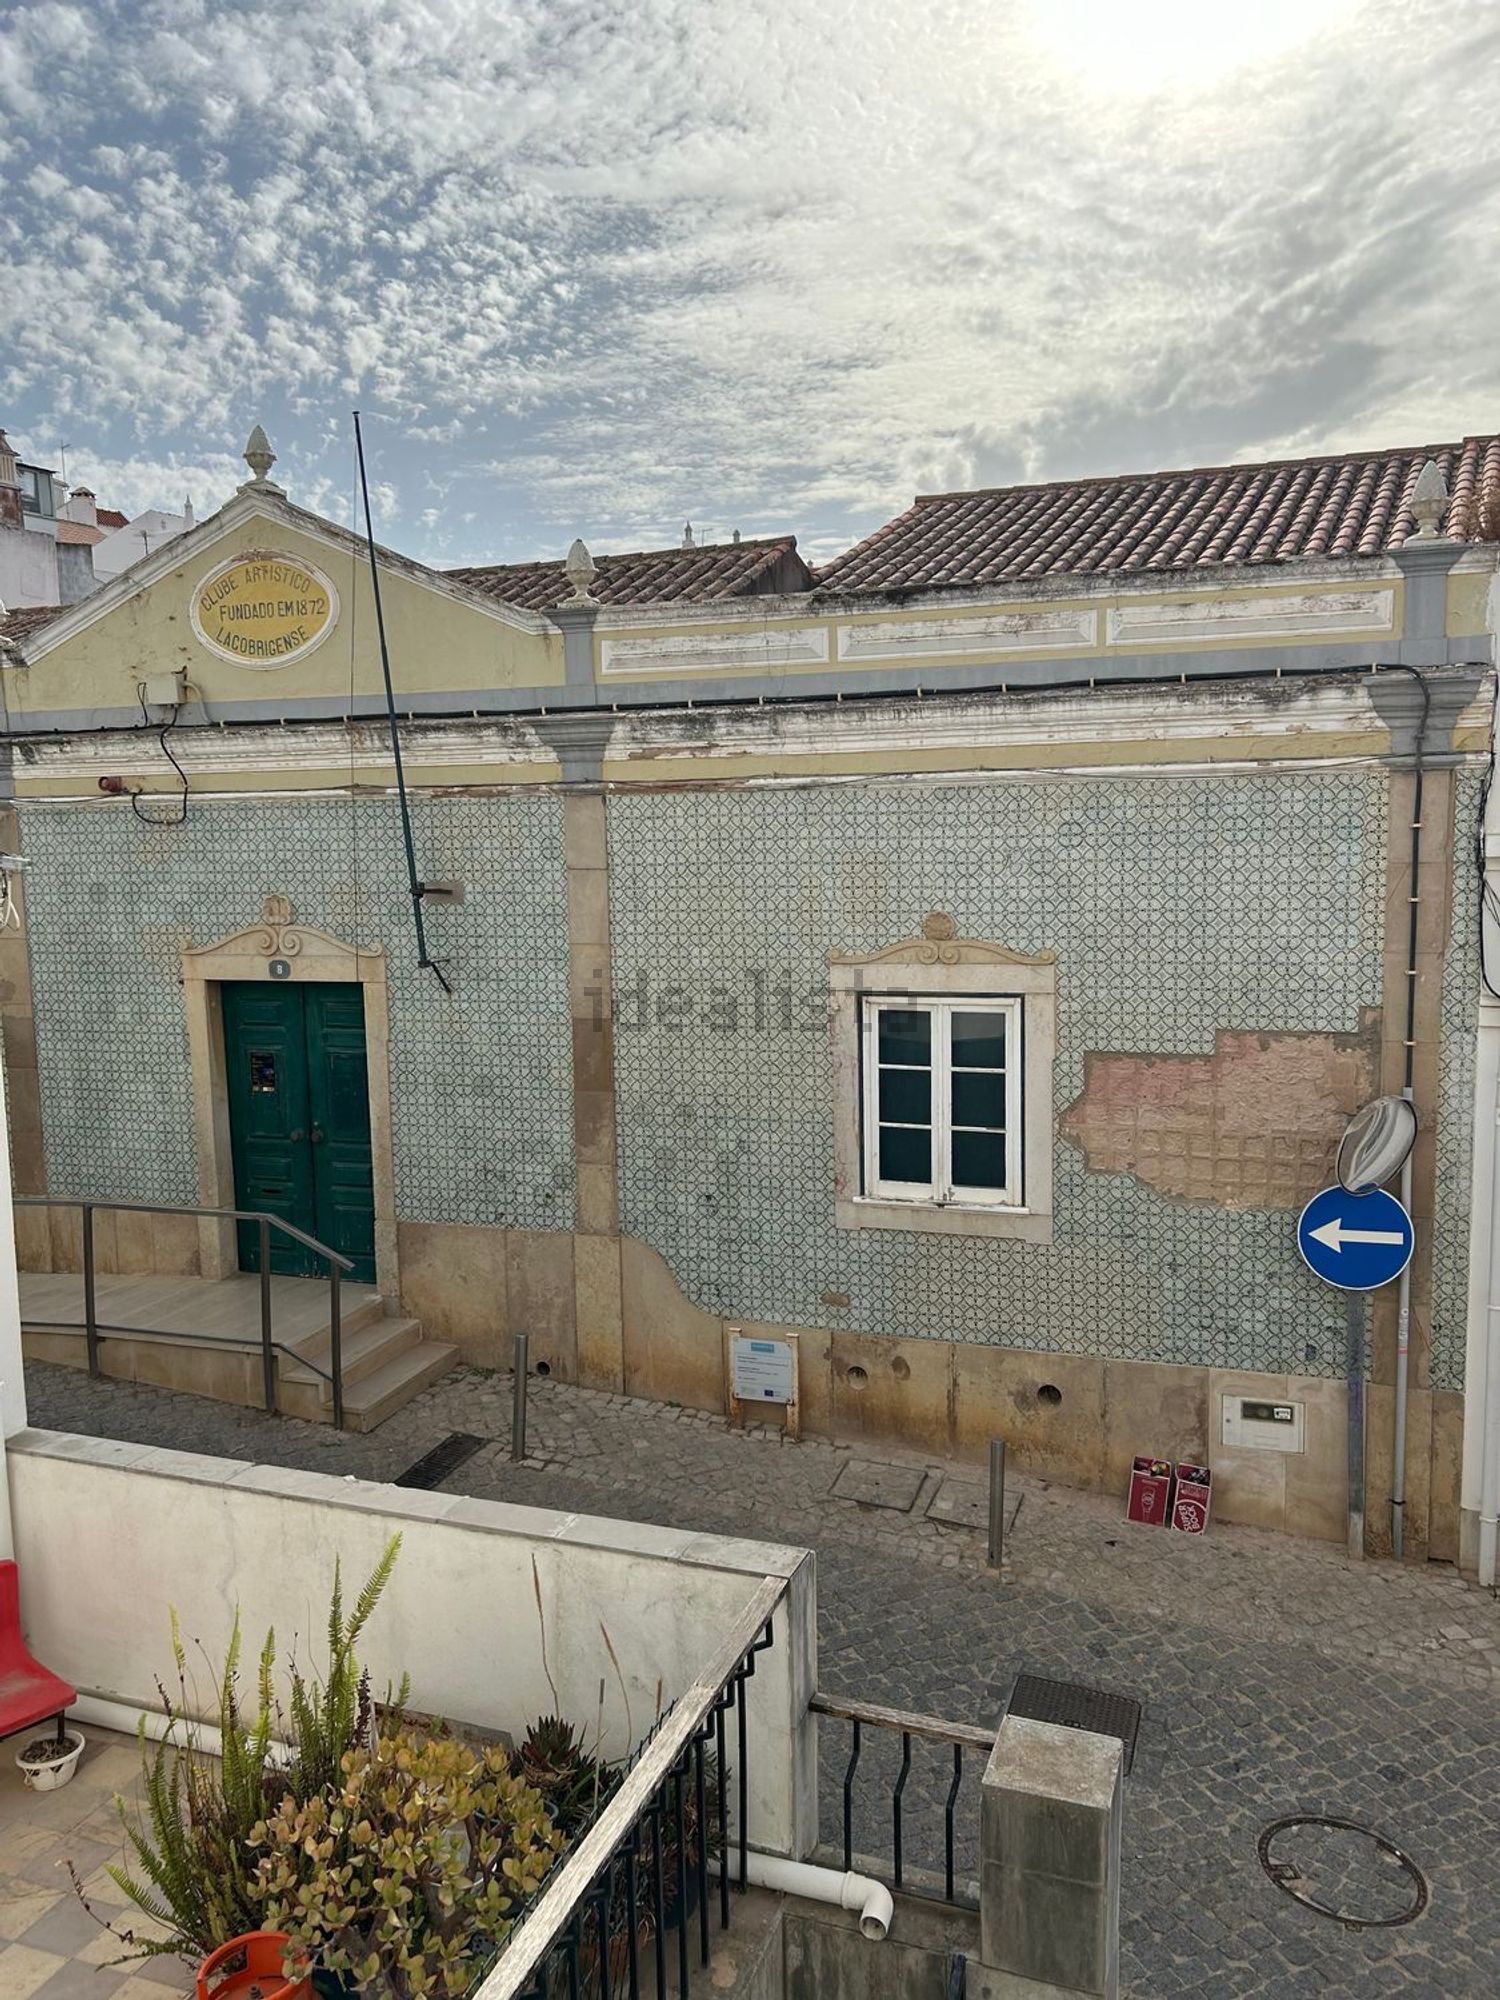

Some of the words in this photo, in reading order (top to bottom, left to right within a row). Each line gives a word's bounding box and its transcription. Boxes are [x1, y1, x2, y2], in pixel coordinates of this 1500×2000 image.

[201, 575, 239, 612] CLUBE
[219, 602, 275, 622] FUNDADO
[277, 601, 294, 618] EM
[296, 598, 325, 616] 1872
[216, 625, 309, 656] LACOBRIGENSE
[1178, 1504, 1194, 1532] SUPER
[1186, 1504, 1200, 1530] BOCK
